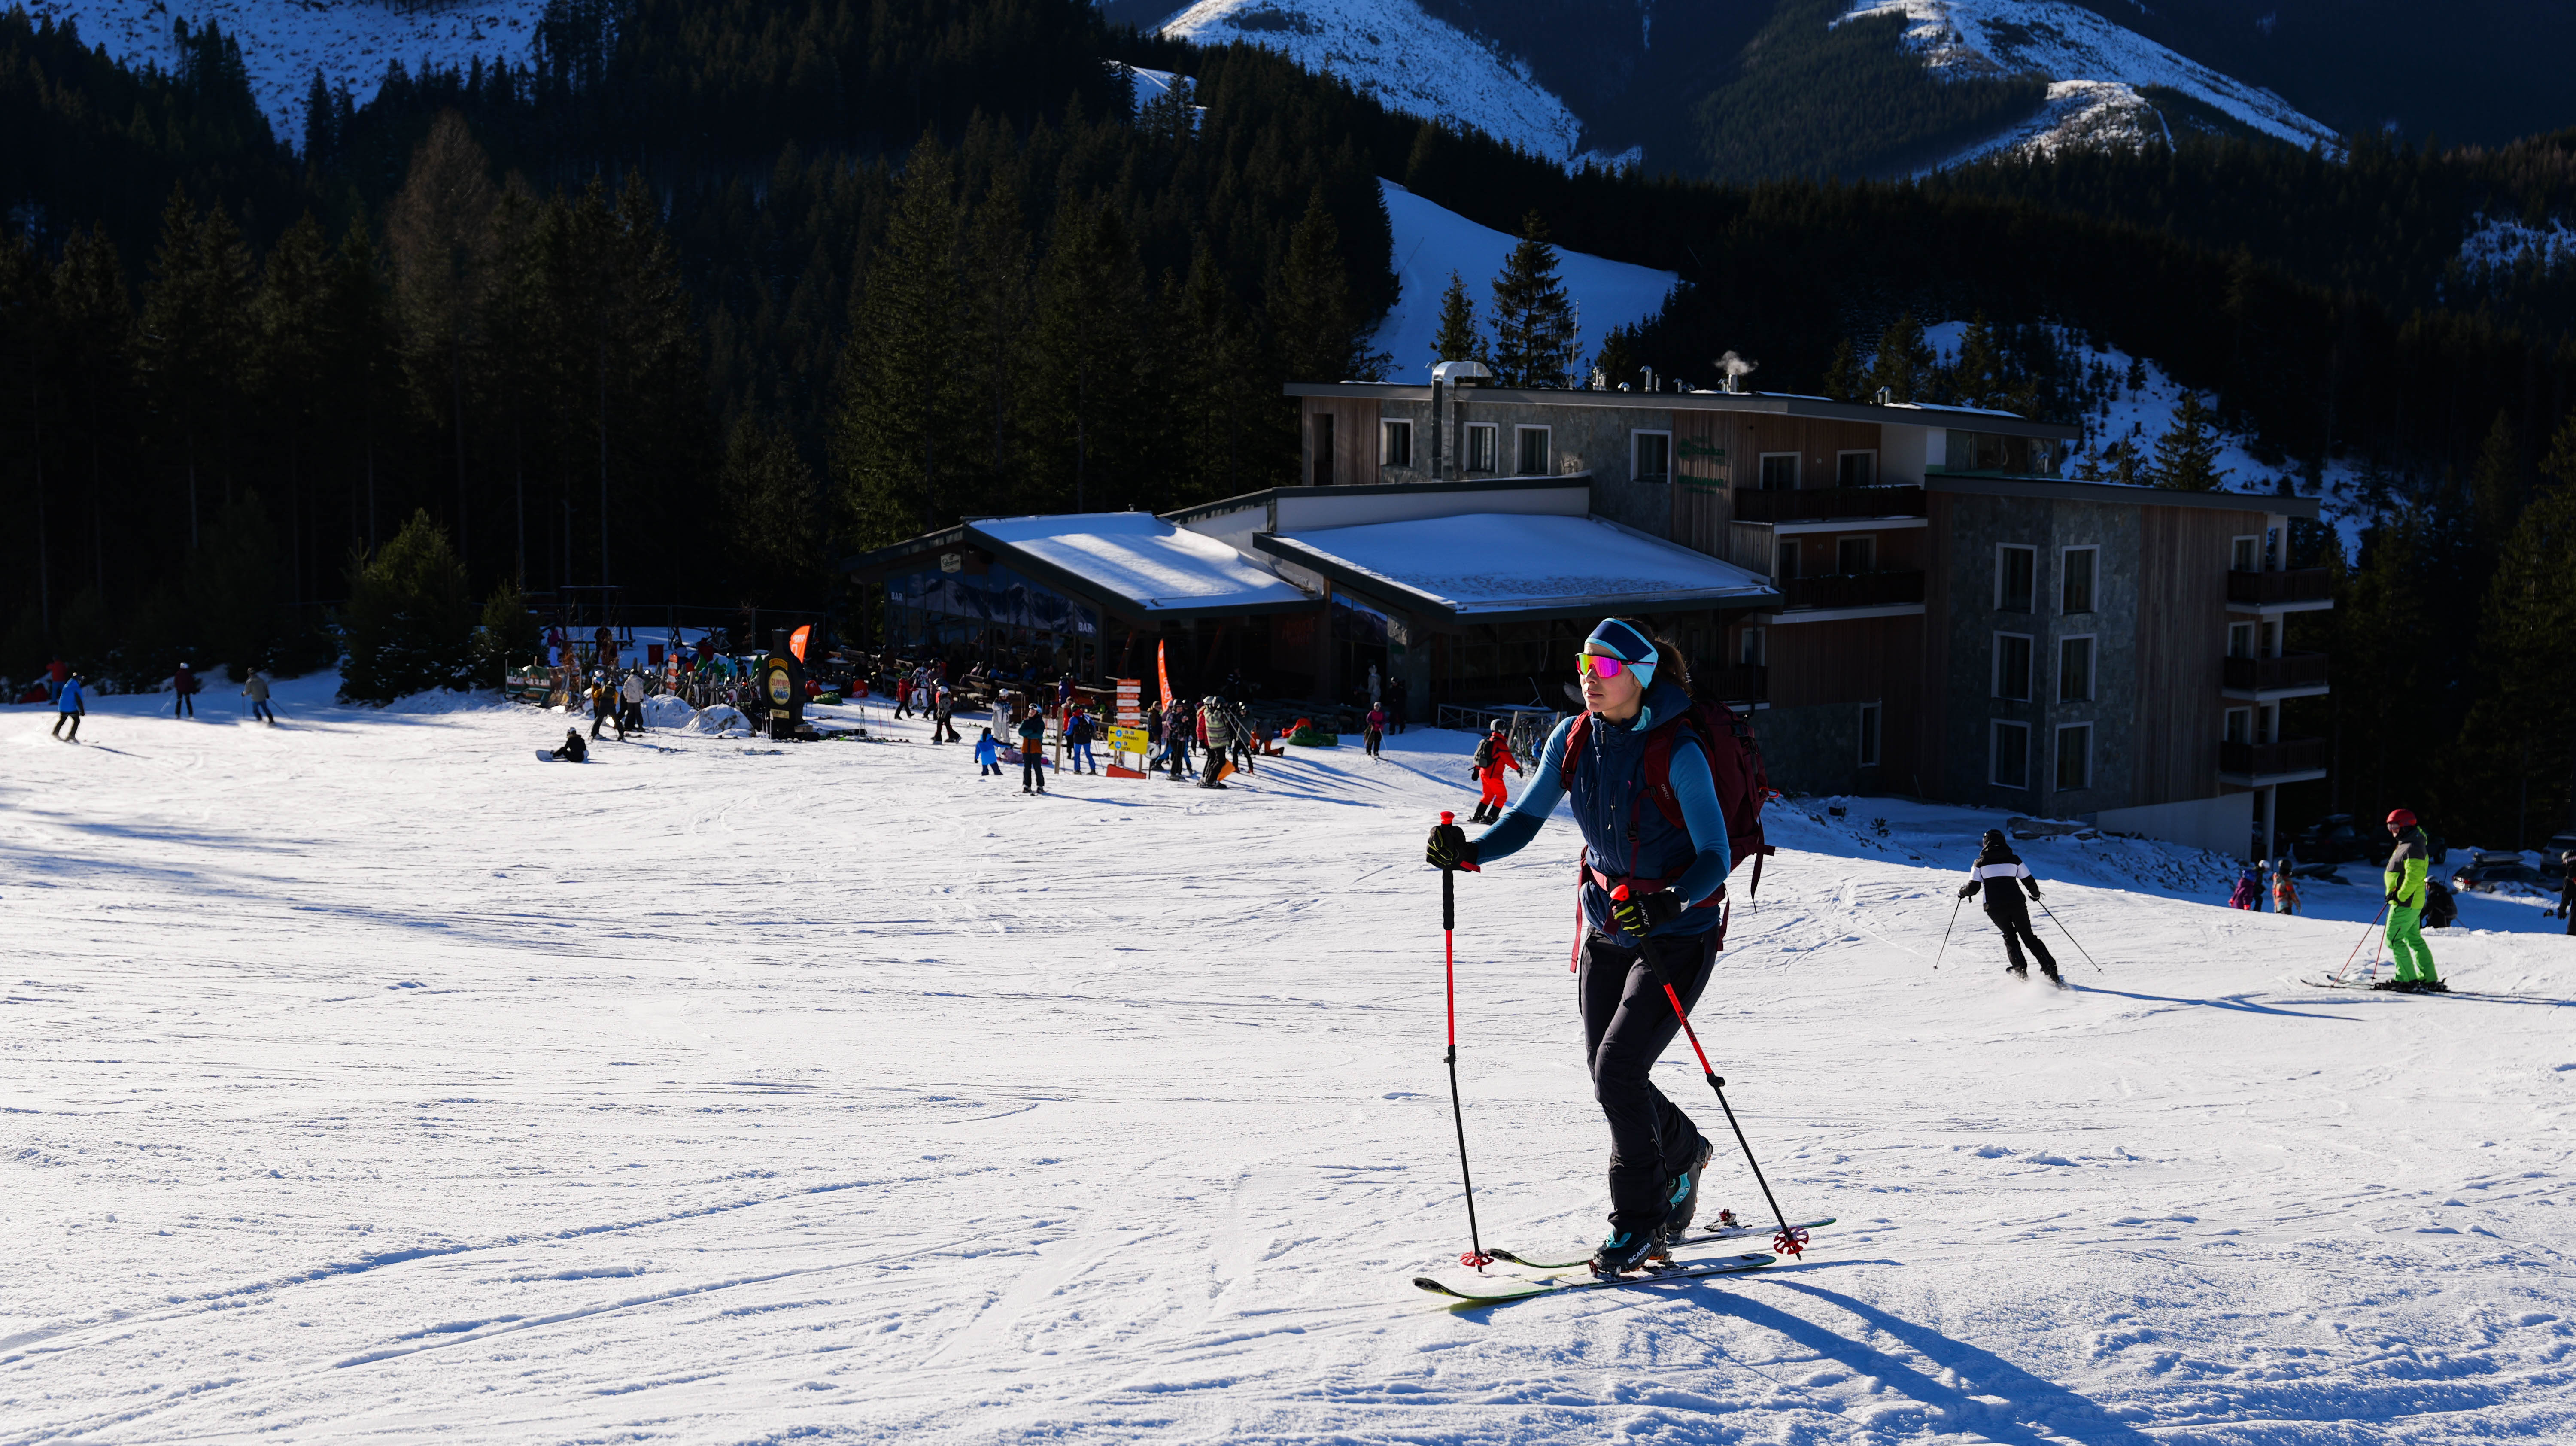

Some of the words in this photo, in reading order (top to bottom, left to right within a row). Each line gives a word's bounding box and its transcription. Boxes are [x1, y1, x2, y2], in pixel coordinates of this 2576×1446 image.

[1677, 475, 1724, 486] RESTAURANT
[891, 591, 903, 601] BAR
[1078, 621, 1093, 633] BAR
[772, 678, 790, 688] SLIVOVICE
[1661, 784, 1670, 799] OSPREY
[1678, 1010, 1697, 1042] COBER
[1628, 1242, 1651, 1264] SCARPA
